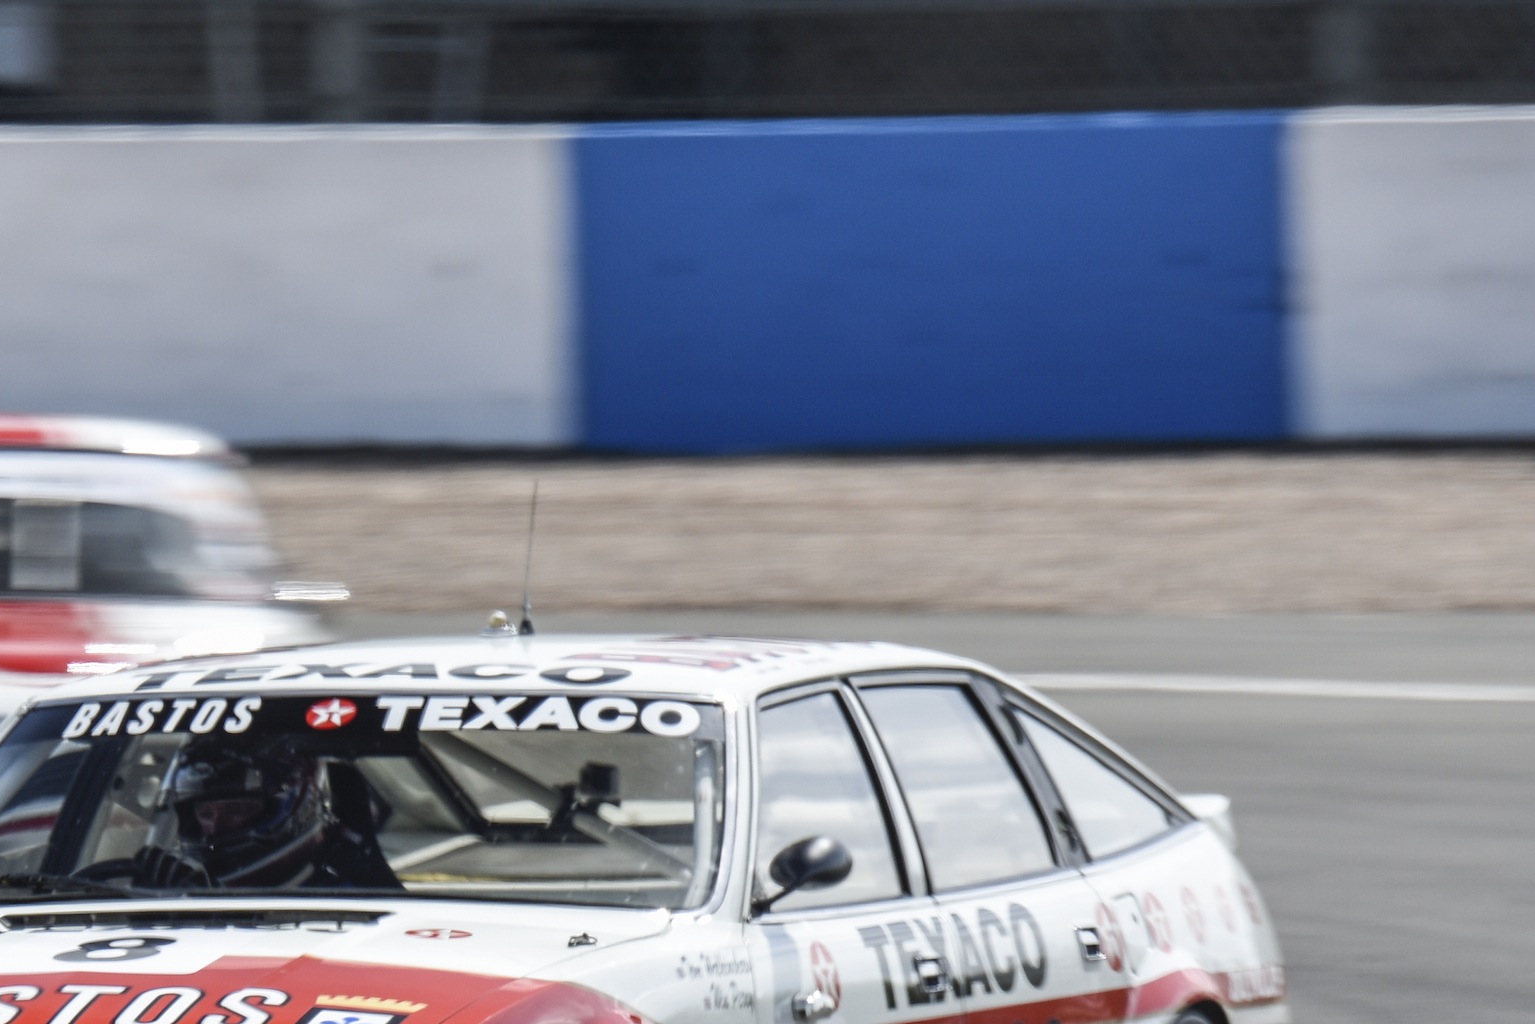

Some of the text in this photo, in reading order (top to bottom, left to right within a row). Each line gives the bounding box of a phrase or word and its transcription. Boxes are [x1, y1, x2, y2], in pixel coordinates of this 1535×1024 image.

[134, 662, 632, 690] TEXACO
[64, 694, 701, 739] BASTOS TEXACO
[52, 935, 178, 965] 8
[856, 902, 1048, 1011] TEXACO
